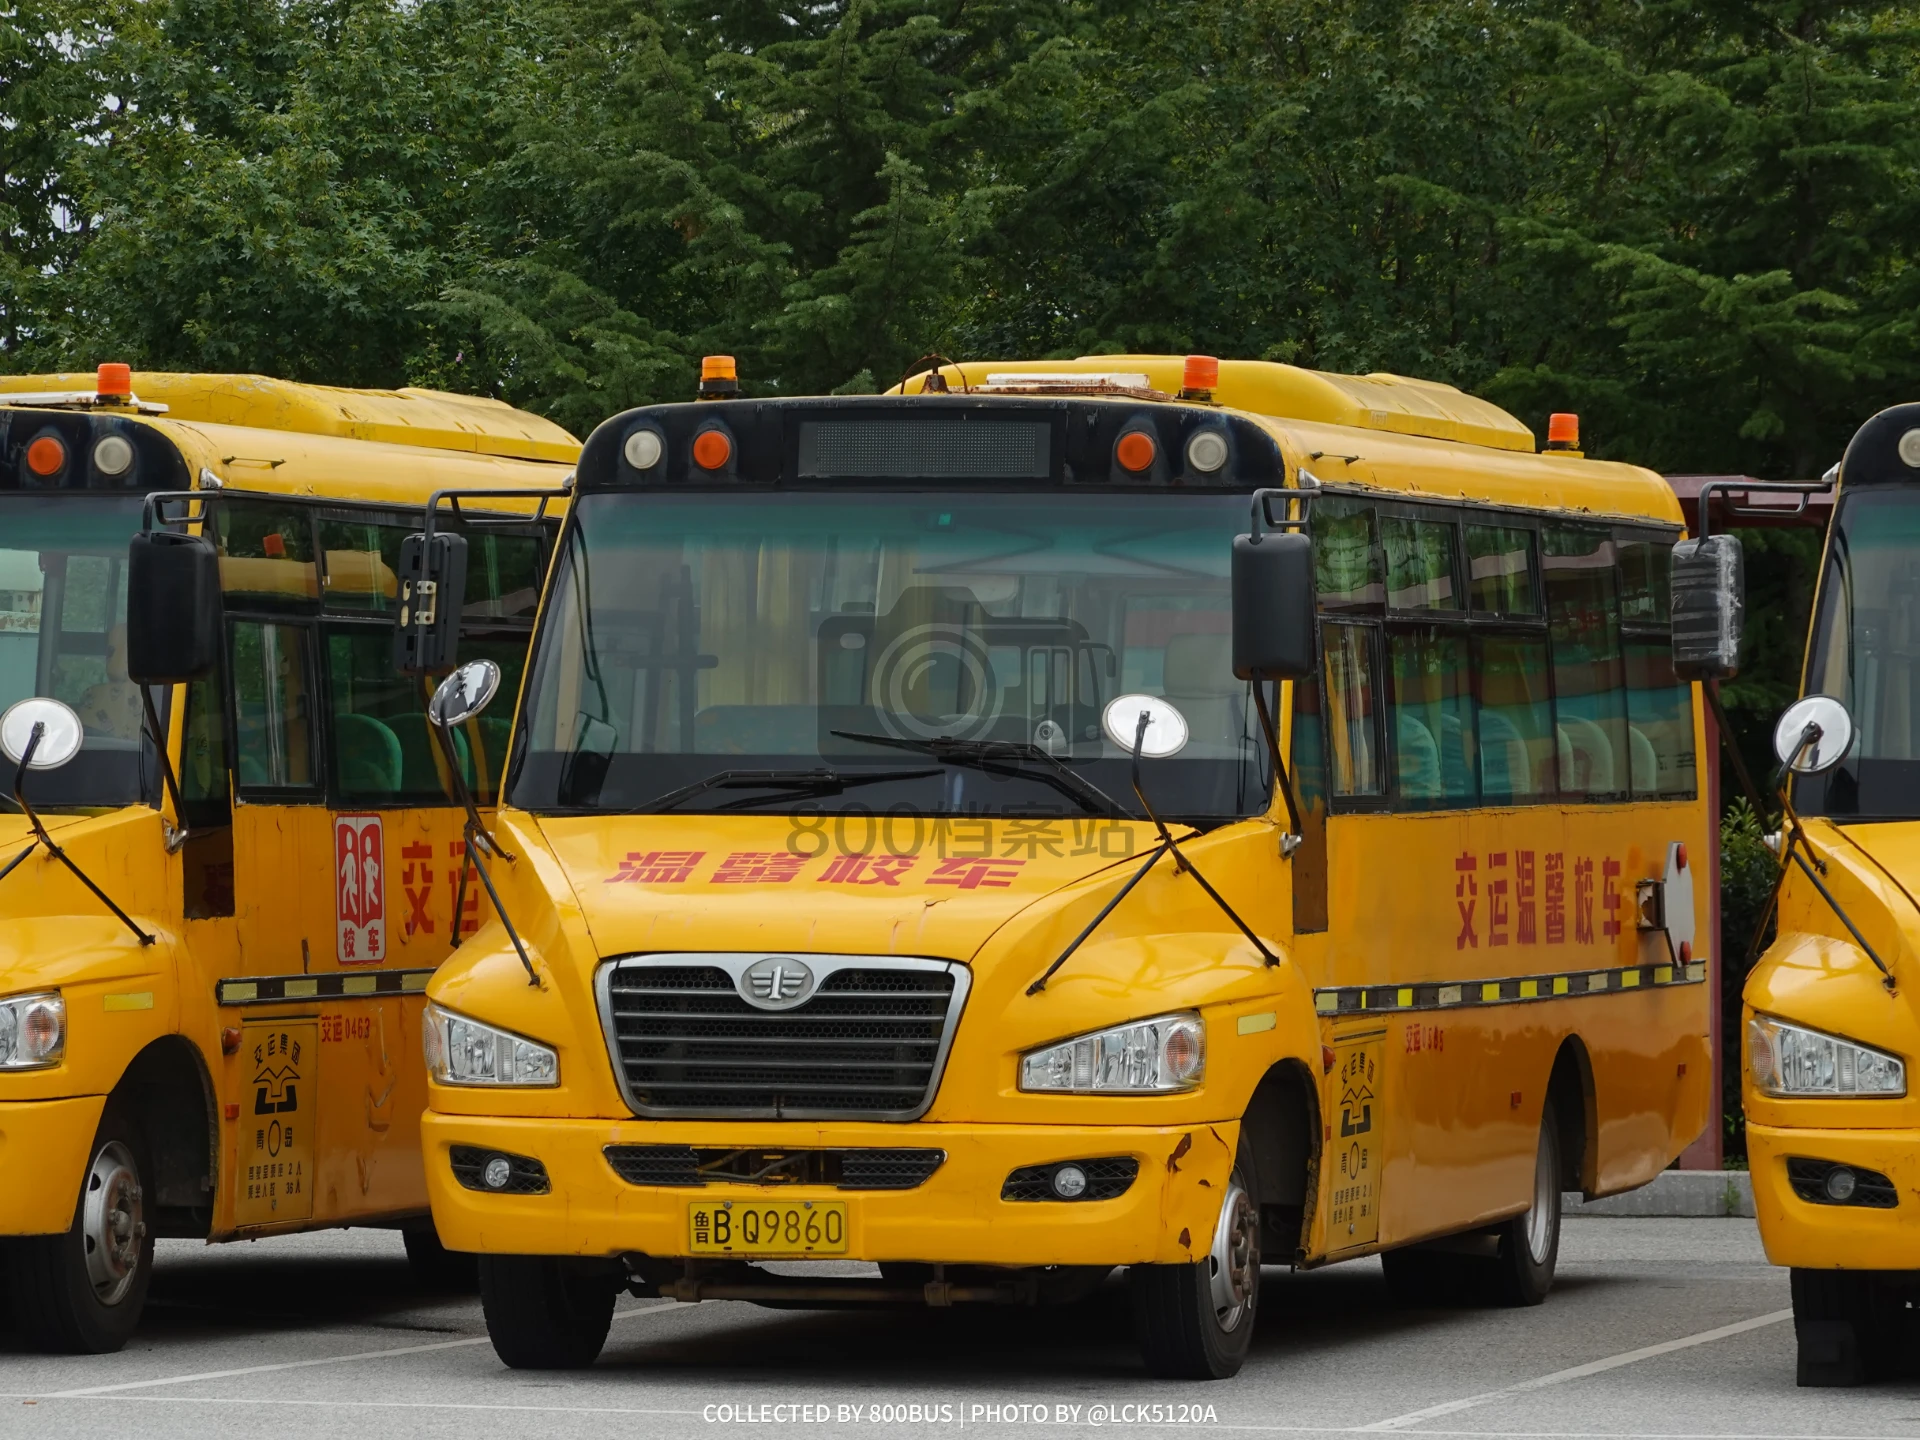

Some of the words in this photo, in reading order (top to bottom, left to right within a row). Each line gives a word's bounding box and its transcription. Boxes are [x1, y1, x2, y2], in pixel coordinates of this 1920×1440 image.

[602, 850, 1028, 890] 温馨校车
[1455, 850, 1621, 950] 交运温馨校车
[343, 926, 380, 957] 校车
